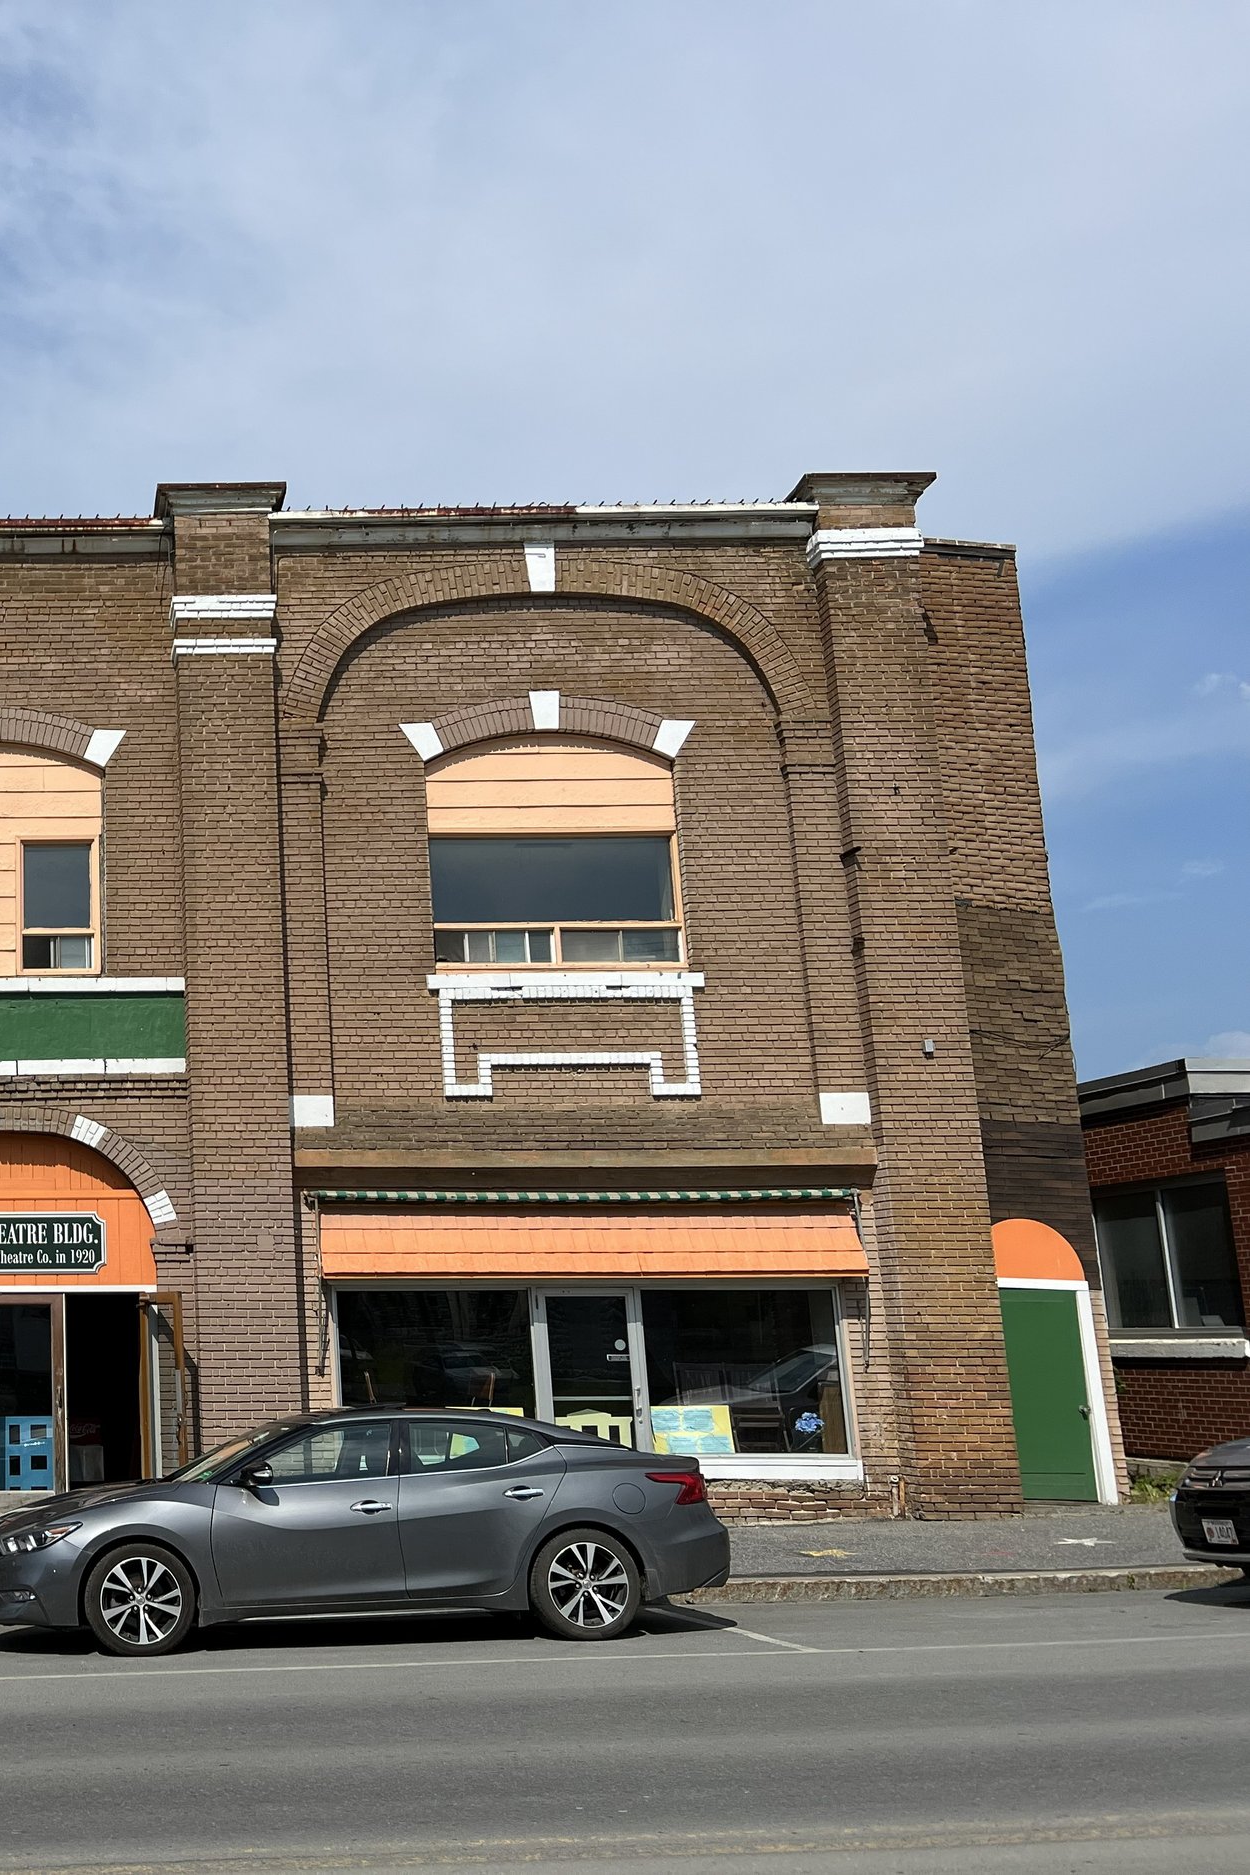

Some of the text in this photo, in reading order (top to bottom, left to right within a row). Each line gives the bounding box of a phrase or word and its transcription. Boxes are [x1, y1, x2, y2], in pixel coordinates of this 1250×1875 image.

[52, 1222, 99, 1244] BLDG.
[36, 1249, 53, 1264] Co.
[55, 1249, 67, 1264] in
[70, 1248, 95, 1264] 1920
